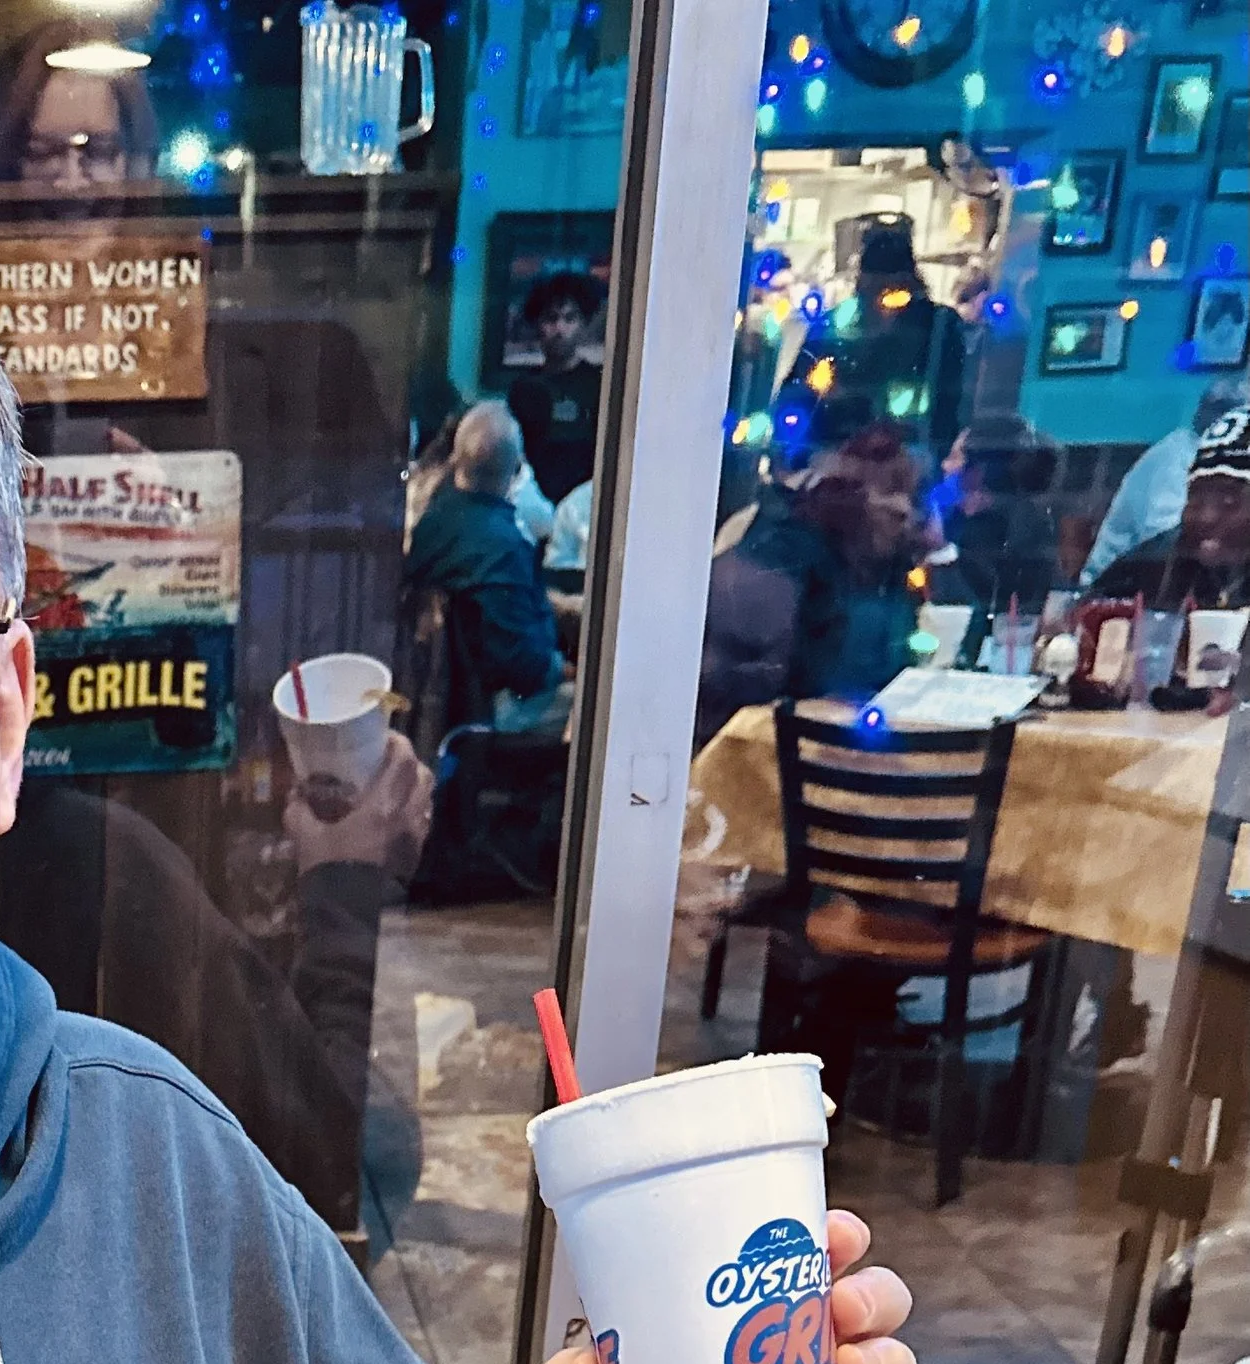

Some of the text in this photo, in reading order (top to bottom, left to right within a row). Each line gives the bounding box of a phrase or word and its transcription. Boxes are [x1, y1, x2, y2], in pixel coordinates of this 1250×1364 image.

[88, 258, 201, 291] WOMEN
[65, 304, 85, 332] IF
[67, 659, 208, 715] GRILLE
[770, 1226, 788, 1240] THE
[711, 1252, 823, 1303] OYSTER
